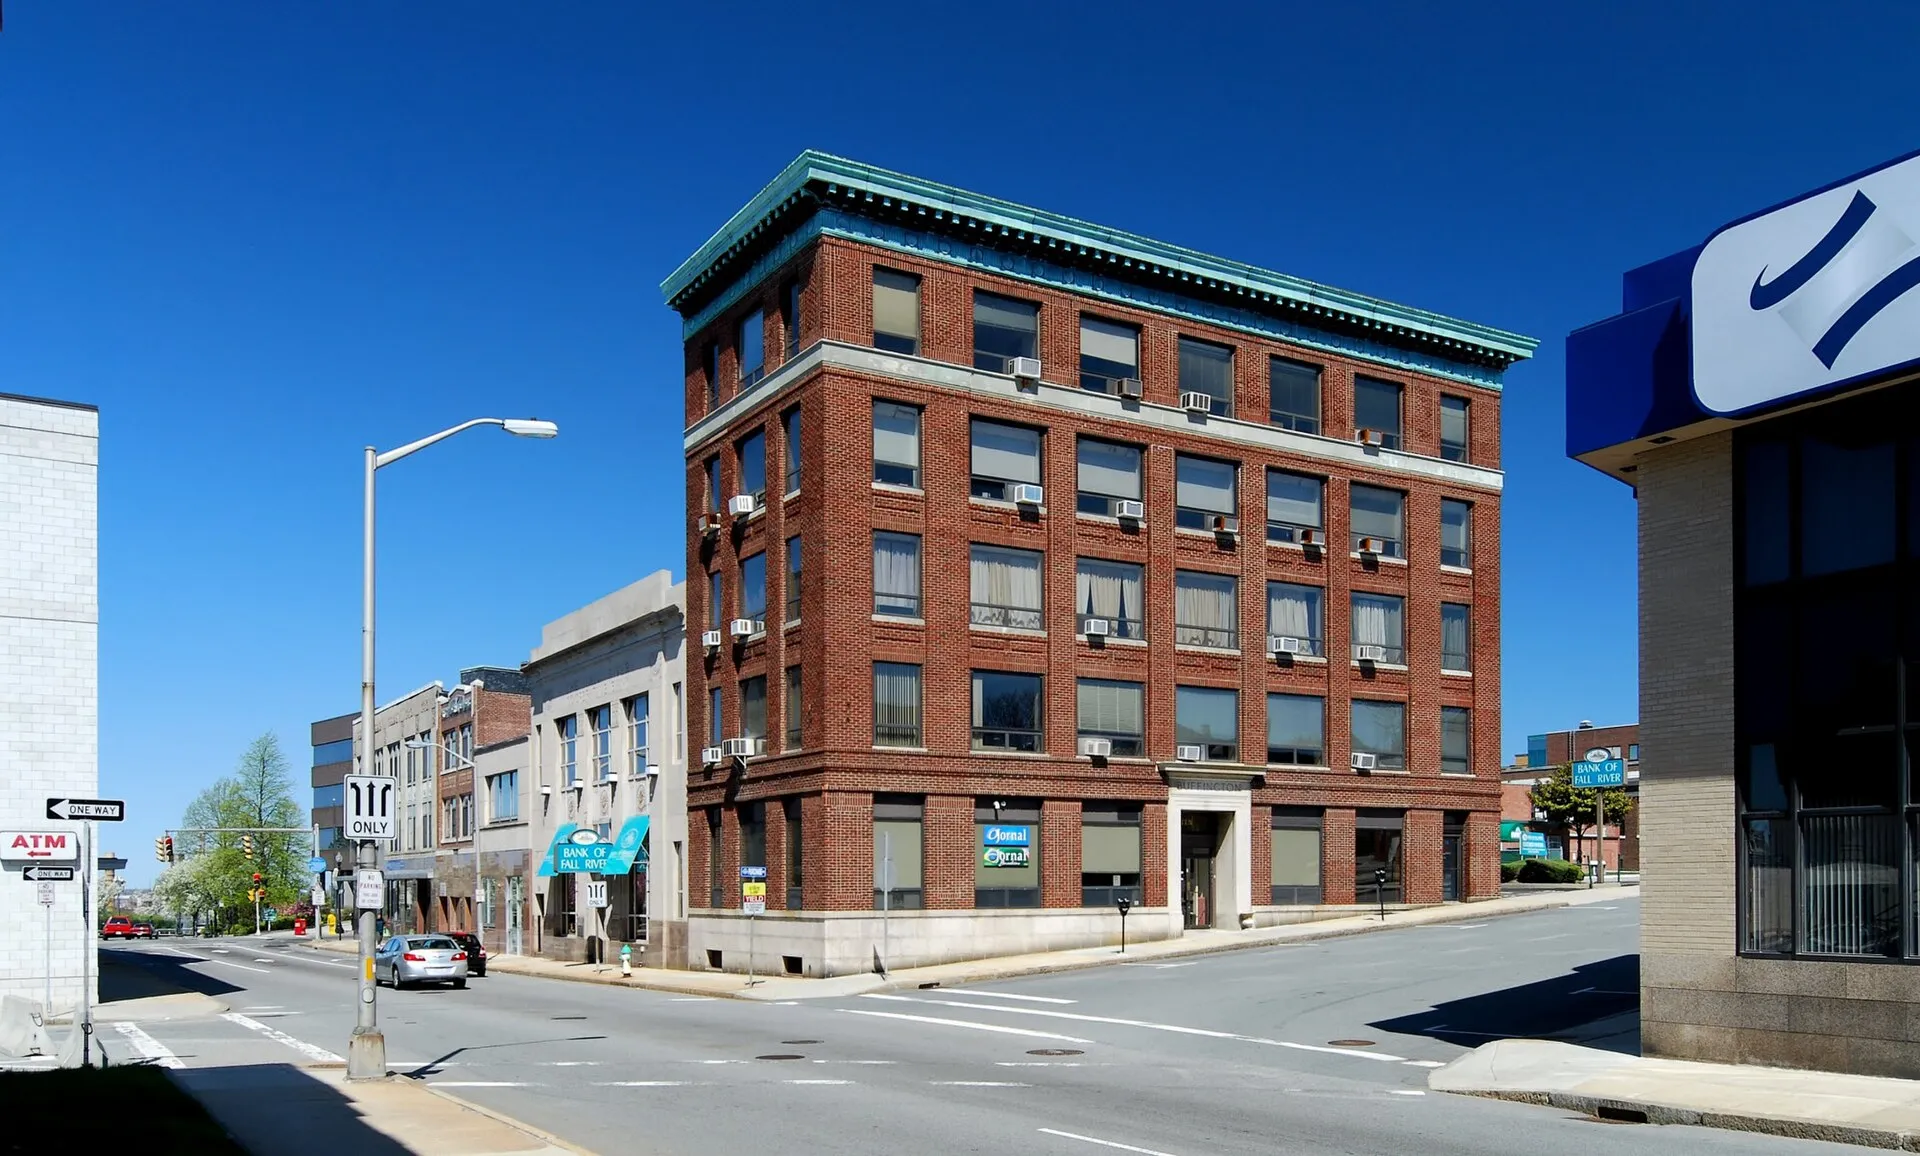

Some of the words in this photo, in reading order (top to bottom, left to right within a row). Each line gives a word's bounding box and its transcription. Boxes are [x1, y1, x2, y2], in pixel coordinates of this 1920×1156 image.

[1577, 763, 1600, 774] BANK
[1605, 762, 1618, 772] OF
[1574, 775, 1592, 785] FALL
[1597, 773, 1621, 783] RIVER
[69, 805, 91, 815] ONE
[94, 806, 116, 815] WAY
[353, 821, 388, 834] ONLY
[11, 834, 66, 849] ATM
[563, 847, 588, 858] BANK
[594, 847, 606, 857] OF
[560, 859, 579, 869] FALL
[585, 859, 608, 869] RIVE
